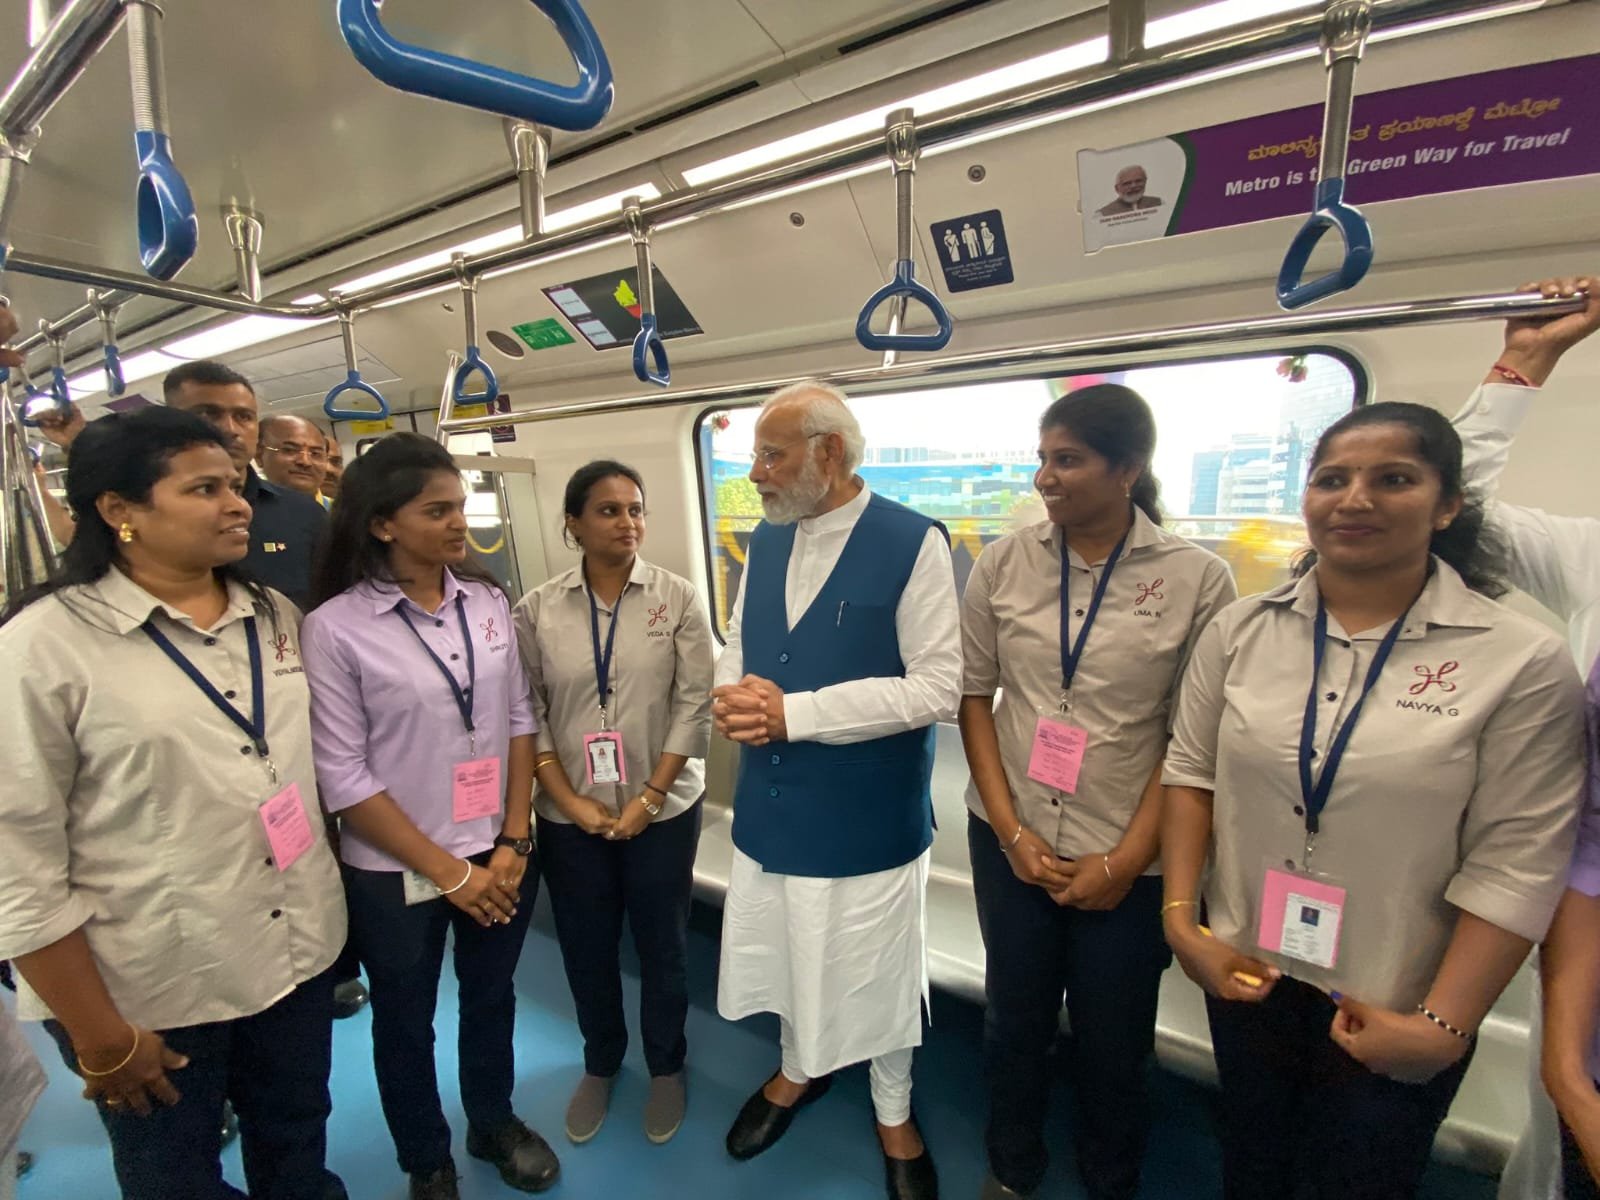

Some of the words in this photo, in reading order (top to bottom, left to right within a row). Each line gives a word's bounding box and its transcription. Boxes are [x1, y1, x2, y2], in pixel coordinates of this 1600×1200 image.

[1225, 176, 1280, 196] Metro
[1286, 171, 1303, 185] is
[1347, 154, 1407, 175] Green
[1414, 146, 1458, 165] Way
[1464, 140, 1497, 157] for
[1502, 128, 1572, 152] Travel
[1396, 699, 1442, 715] NAVYA
[1448, 708, 1459, 717] G
